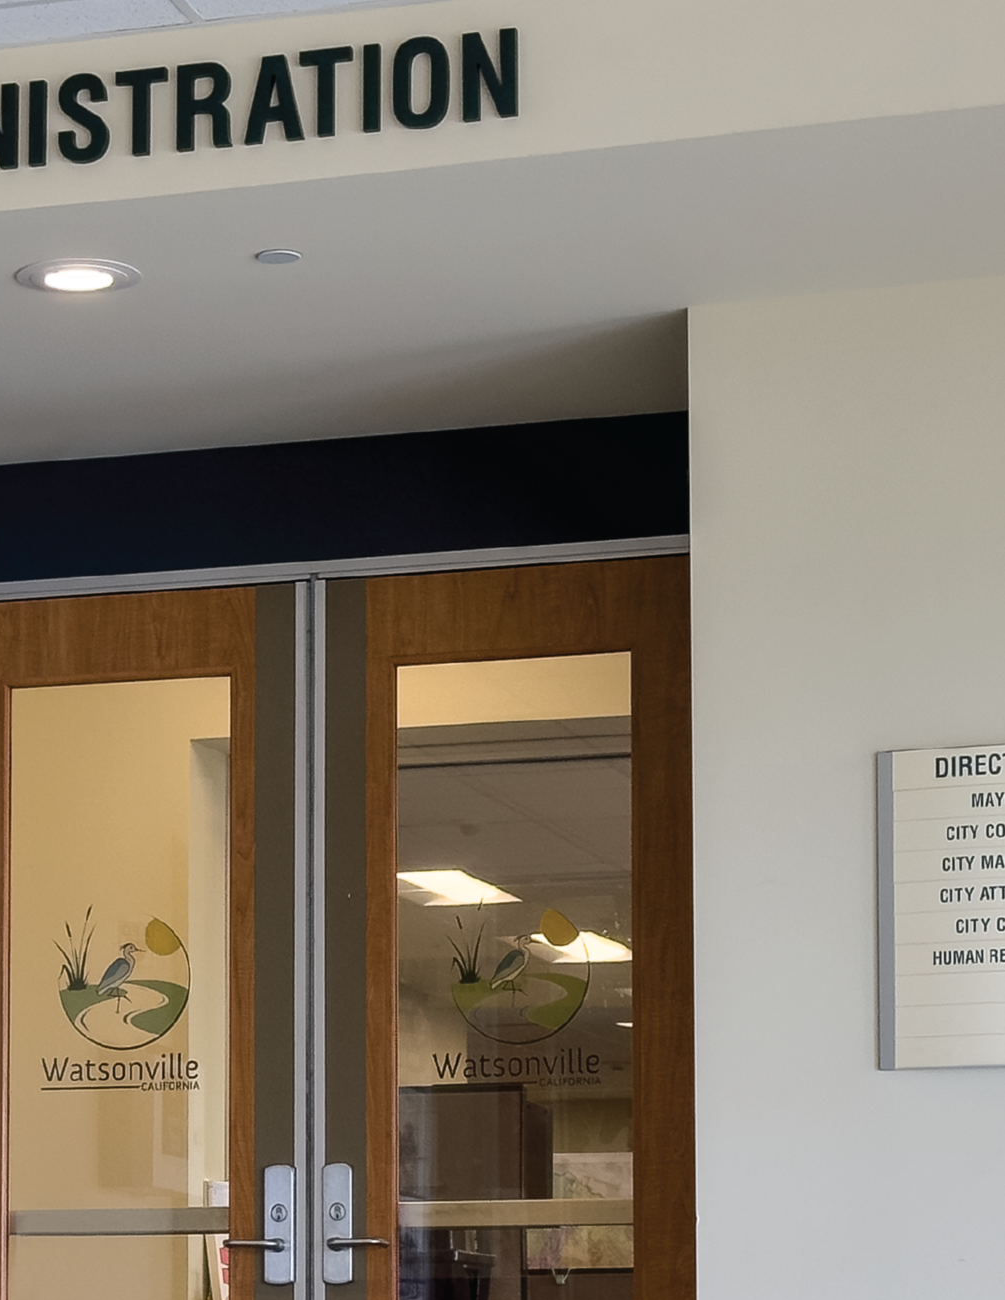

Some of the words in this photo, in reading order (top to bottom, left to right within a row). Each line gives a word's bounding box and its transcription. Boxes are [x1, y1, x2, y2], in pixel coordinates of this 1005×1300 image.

[971, 791, 1005, 808] MAY
[946, 825, 979, 841] CITY
[985, 823, 1005, 839] CO
[942, 856, 975, 872] CITY
[980, 854, 1005, 870] MA
[939, 887, 975, 903] CITY
[979, 885, 1005, 901] ATT
[955, 918, 991, 934] CITY
[932, 949, 984, 966] HUMAN
[41, 1052, 200, 1082] Watsonville
[432, 1047, 601, 1080] Watsonville
[141, 1080, 201, 1092] CALIFORNIA
[538, 1076, 602, 1087] CALIFORNIA
